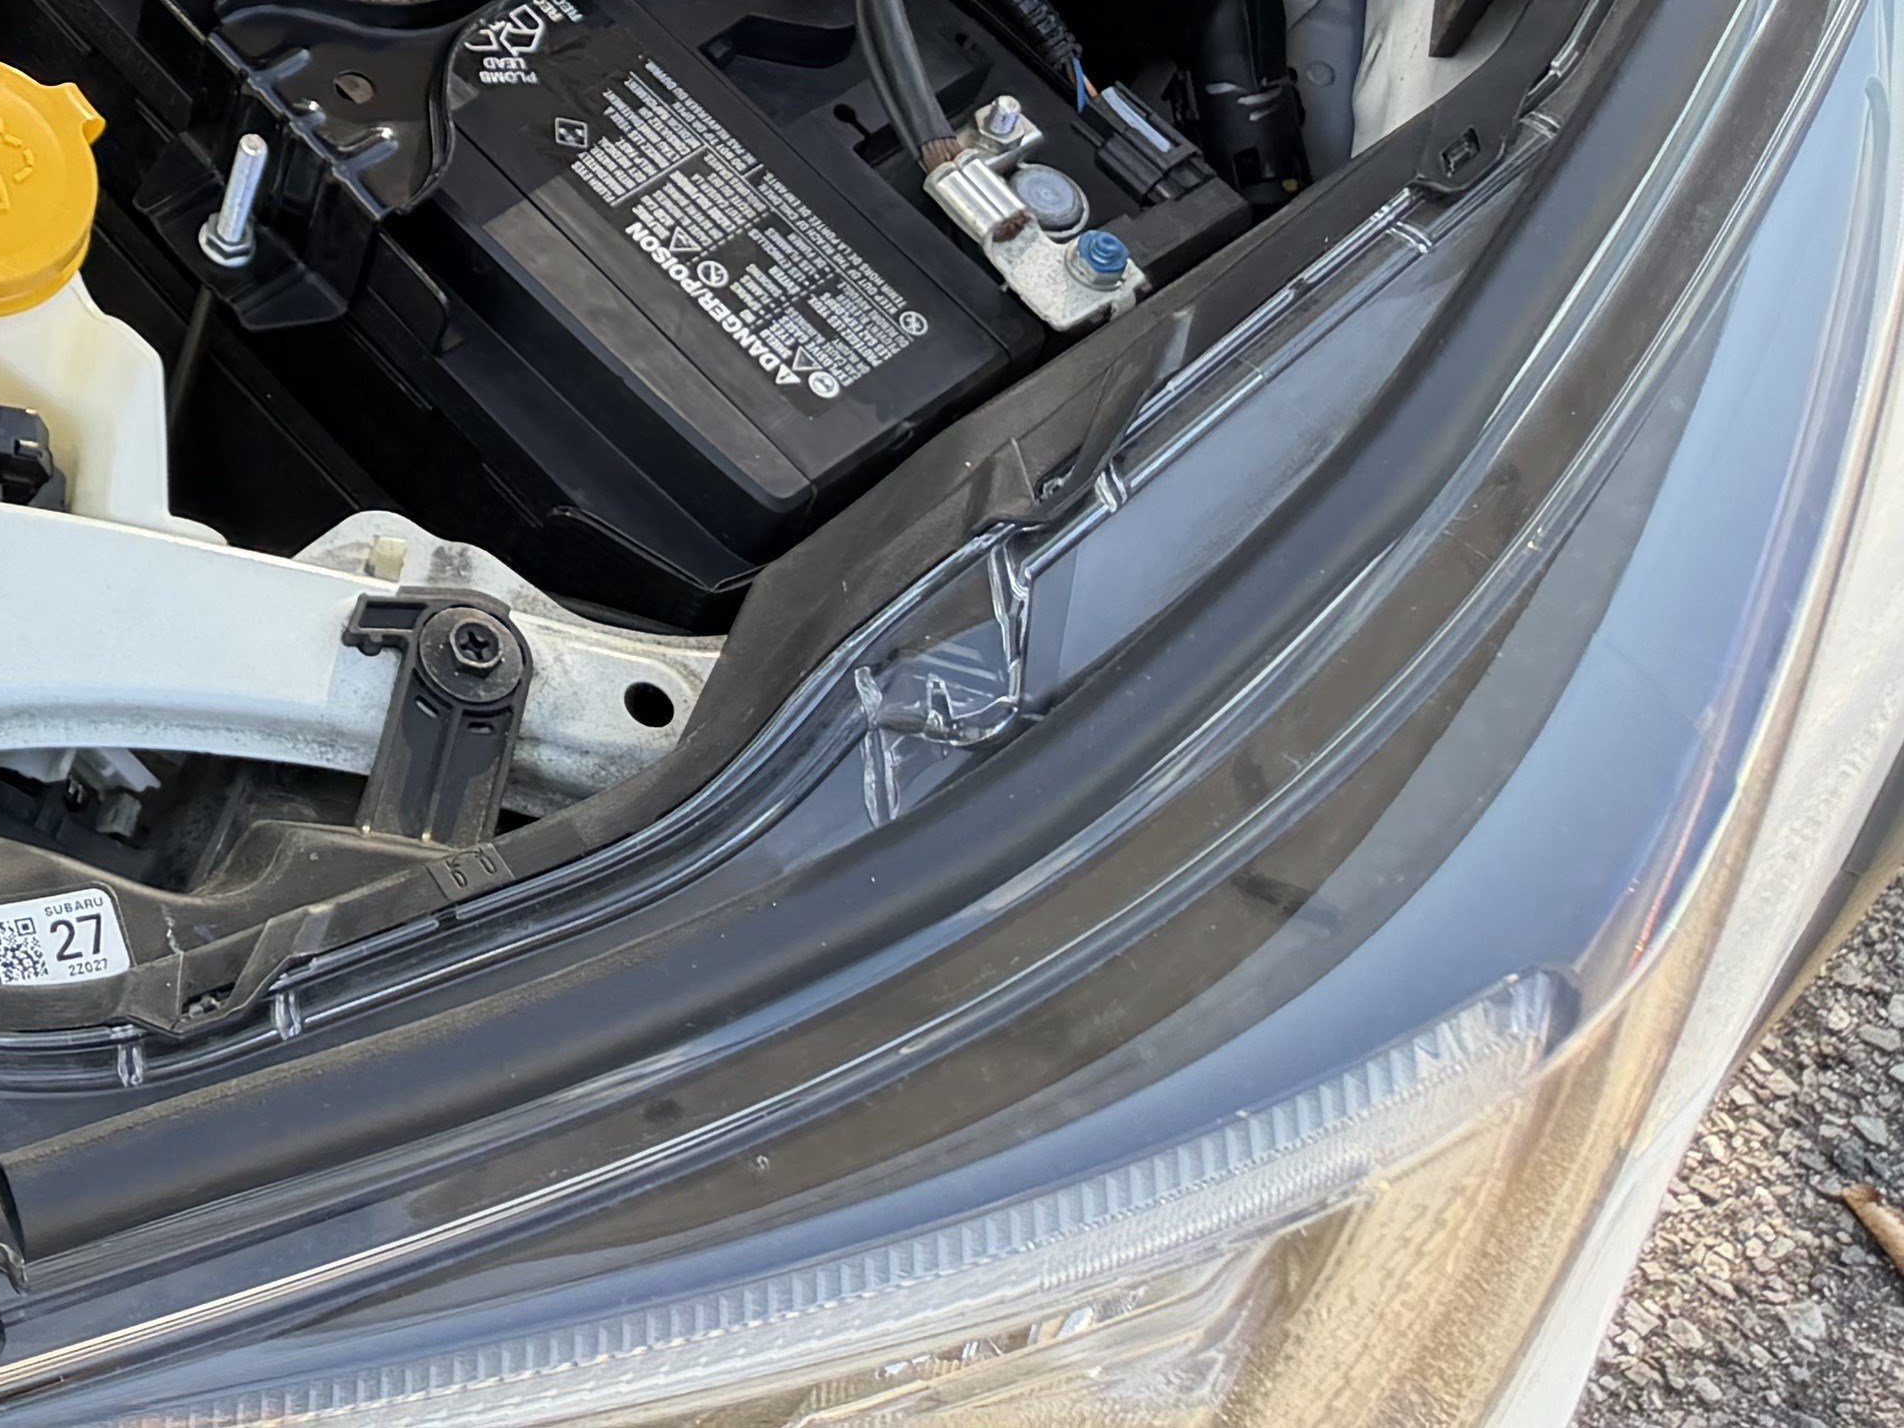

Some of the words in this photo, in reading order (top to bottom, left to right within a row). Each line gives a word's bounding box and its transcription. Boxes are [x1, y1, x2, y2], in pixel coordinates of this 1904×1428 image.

[483, 57, 525, 71] LEAD
[691, 118, 708, 133] OR
[702, 129, 720, 145] TIP
[714, 141, 736, 160] NOT
[730, 156, 747, 172] DO
[689, 172, 704, 185] LA
[794, 216, 812, 231] OF
[763, 225, 803, 263] FLAMMES
[786, 230, 817, 258] FUMER
[804, 226, 837, 256] REACH
[797, 258, 817, 276] LES
[810, 254, 828, 269] DE
[829, 250, 851, 270] THE
[744, 261, 783, 298] SMOKING
[786, 265, 806, 283] LES
[844, 265, 863, 281] OF
[623, 219, 782, 372] DANGER/POISON
[728, 280, 762, 312] SPARKS
[738, 273, 772, 305] FLAMES
[855, 276, 878, 297] OUT
[818, 290, 864, 333] EXPLOSIFS
[871, 292, 898, 316] KEEP
[777, 313, 810, 344] GASES
[825, 313, 846, 332] LES
[758, 327, 793, 359] SHIELD
[857, 328, 879, 347] GAZ
[872, 342, 892, 361] LES
[803, 339, 854, 387] EXPLOSIVE
[44, 897, 104, 917] SUBARU
[49, 913, 102, 962] 27
